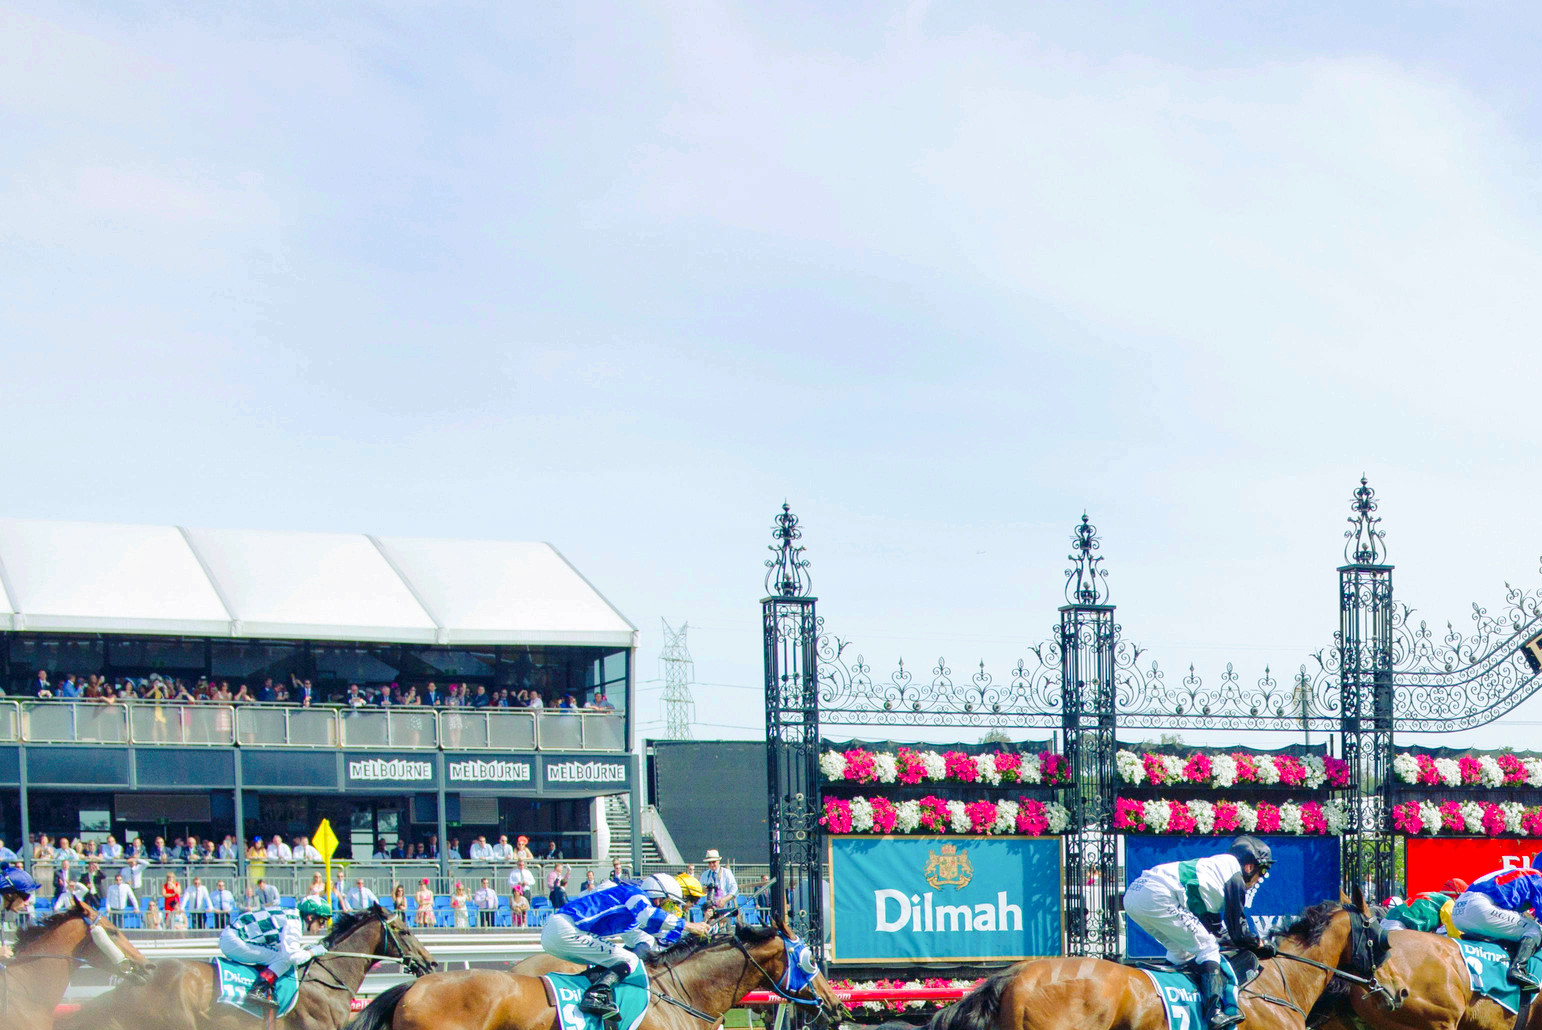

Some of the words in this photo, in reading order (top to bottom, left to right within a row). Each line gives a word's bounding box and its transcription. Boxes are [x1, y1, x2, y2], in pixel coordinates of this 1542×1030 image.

[351, 759, 431, 780] MELBOURNE
[450, 760, 530, 781] MELBOURNE
[548, 761, 625, 782] MELBOURNE
[874, 889, 1023, 932] Dilmah
[560, 988, 582, 1001] Dil
